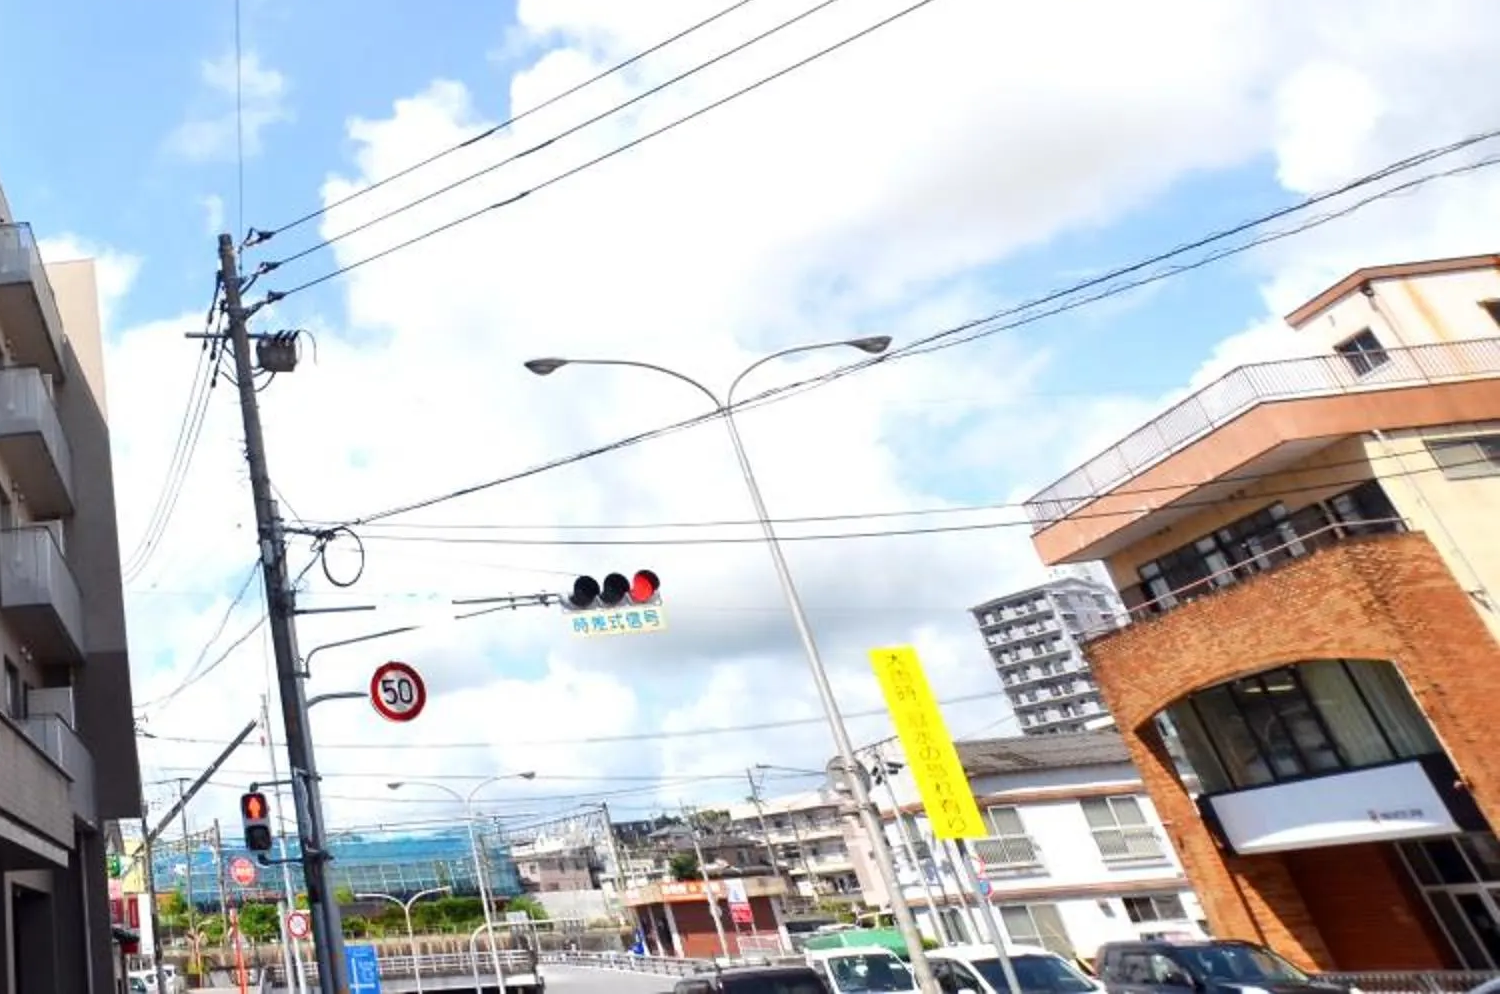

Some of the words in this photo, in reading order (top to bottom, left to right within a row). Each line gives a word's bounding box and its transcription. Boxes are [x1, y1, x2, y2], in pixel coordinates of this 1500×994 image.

[572, 609, 660, 633] 時差式信号
[381, 677, 414, 705] 50
